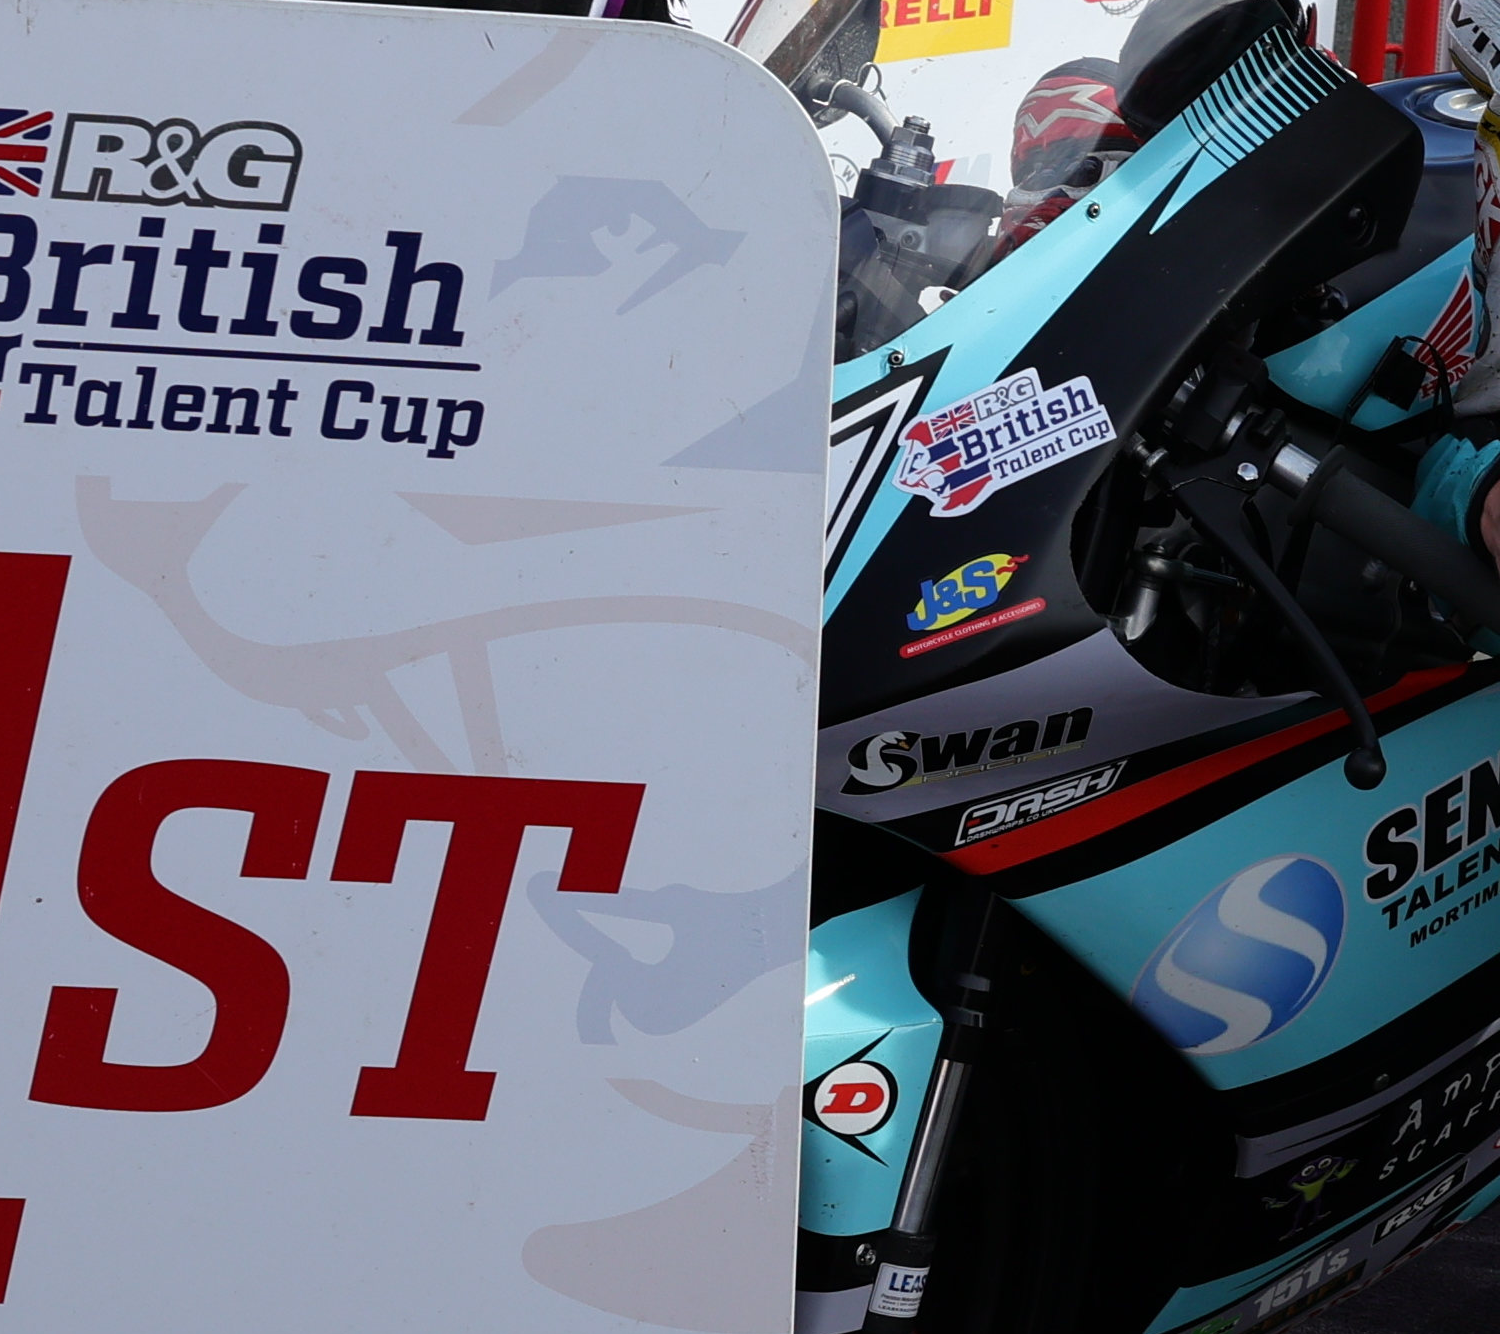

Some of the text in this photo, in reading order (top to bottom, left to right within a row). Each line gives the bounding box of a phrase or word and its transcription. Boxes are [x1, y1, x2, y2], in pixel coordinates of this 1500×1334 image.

[53, 113, 302, 209] R&G
[20, 364, 485, 459] Talent Cup
[958, 385, 1095, 466] British
[975, 377, 1037, 420] R&G
[993, 418, 1111, 480] Talent Cup
[906, 560, 999, 632] J&S
[841, 704, 1095, 796] Swan
[1380, 1173, 1457, 1238] R&G
